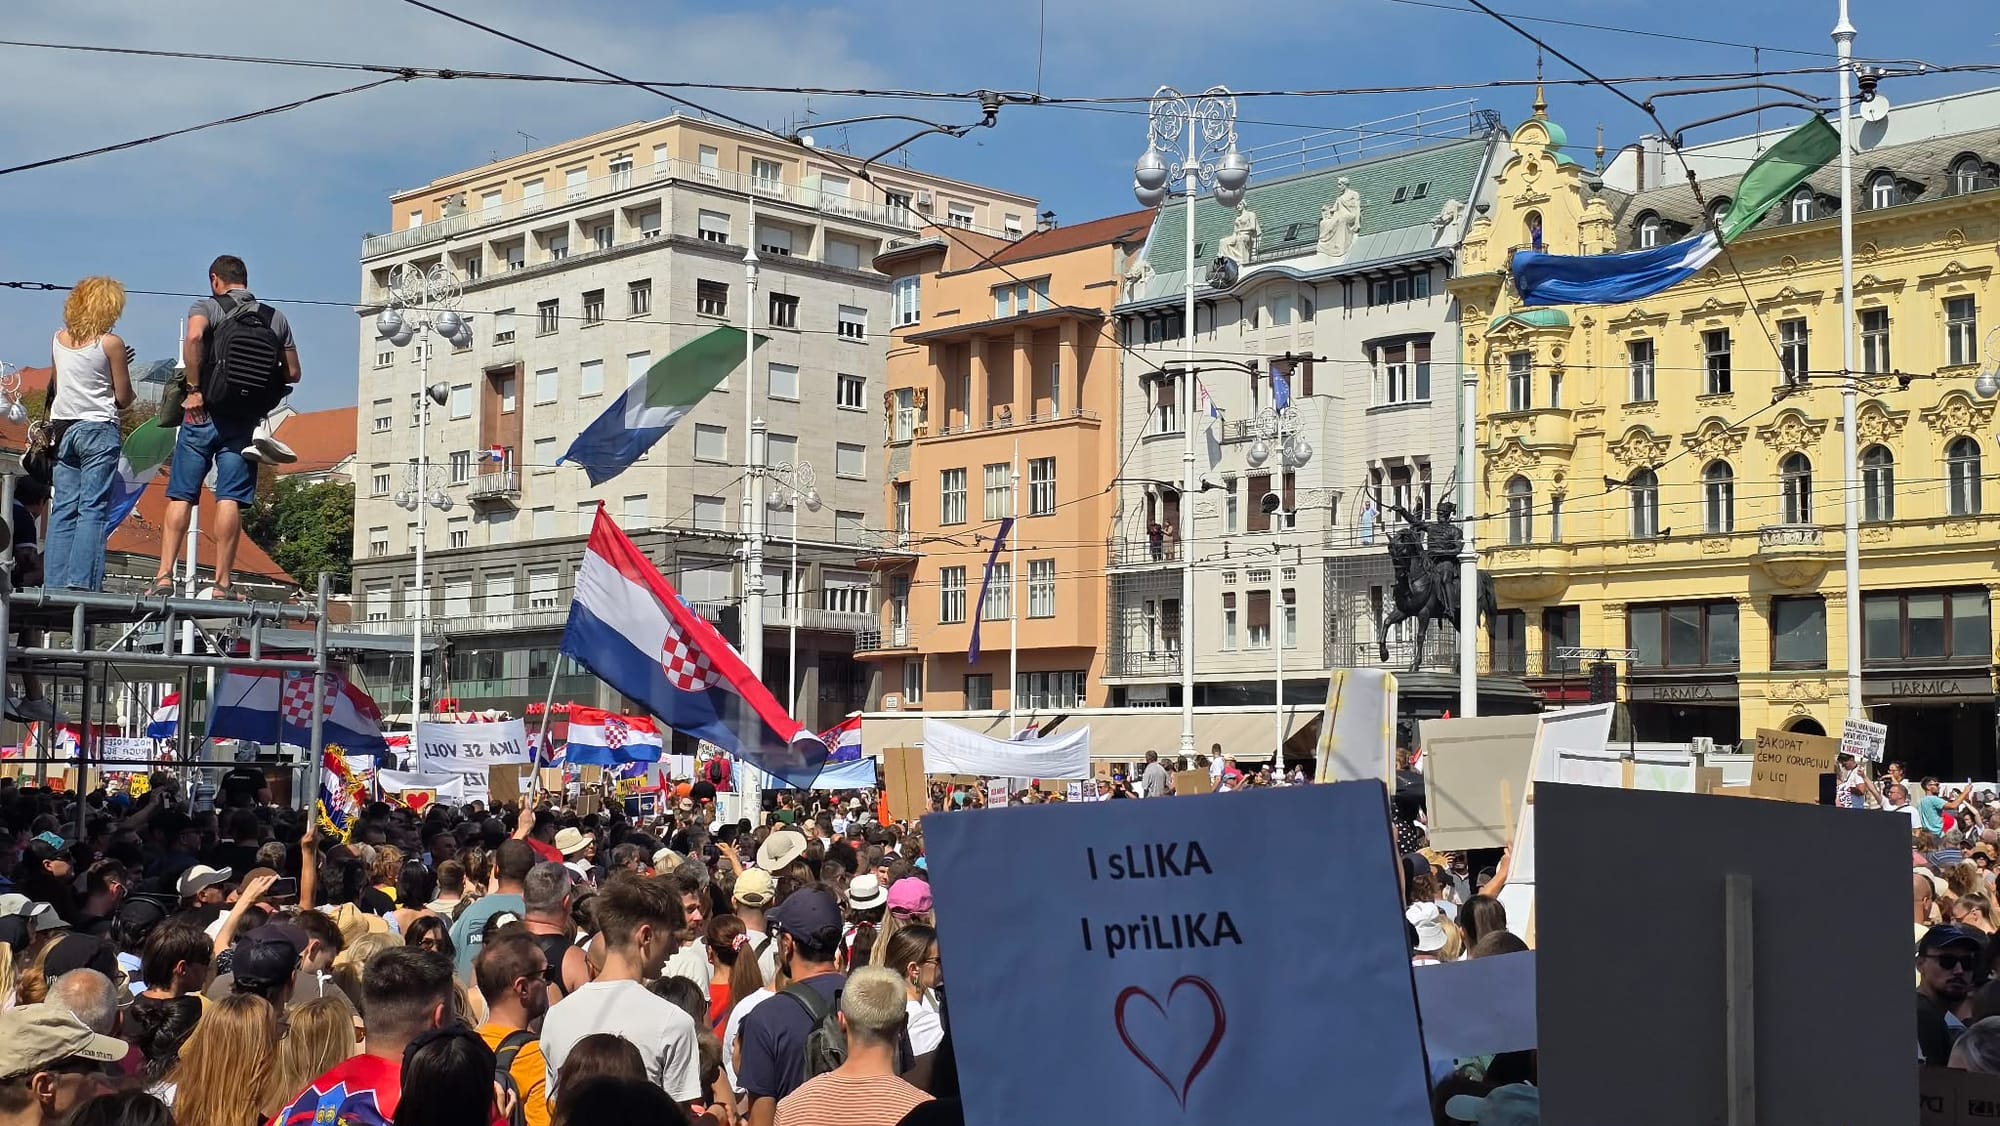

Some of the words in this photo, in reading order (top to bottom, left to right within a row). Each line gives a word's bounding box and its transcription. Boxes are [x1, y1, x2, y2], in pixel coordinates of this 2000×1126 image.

[1653, 687, 1713, 700] HARMICA
[1891, 680, 1961, 695] HARMICA
[1786, 755, 1829, 769] KORUPCIJU
[1757, 773, 1763, 781] U
[1769, 772, 1787, 784] LICI
[1086, 847, 1098, 880] I
[1108, 841, 1213, 880] sLIKA
[1081, 917, 1092, 951] I
[1104, 911, 1243, 959] priLIKA
